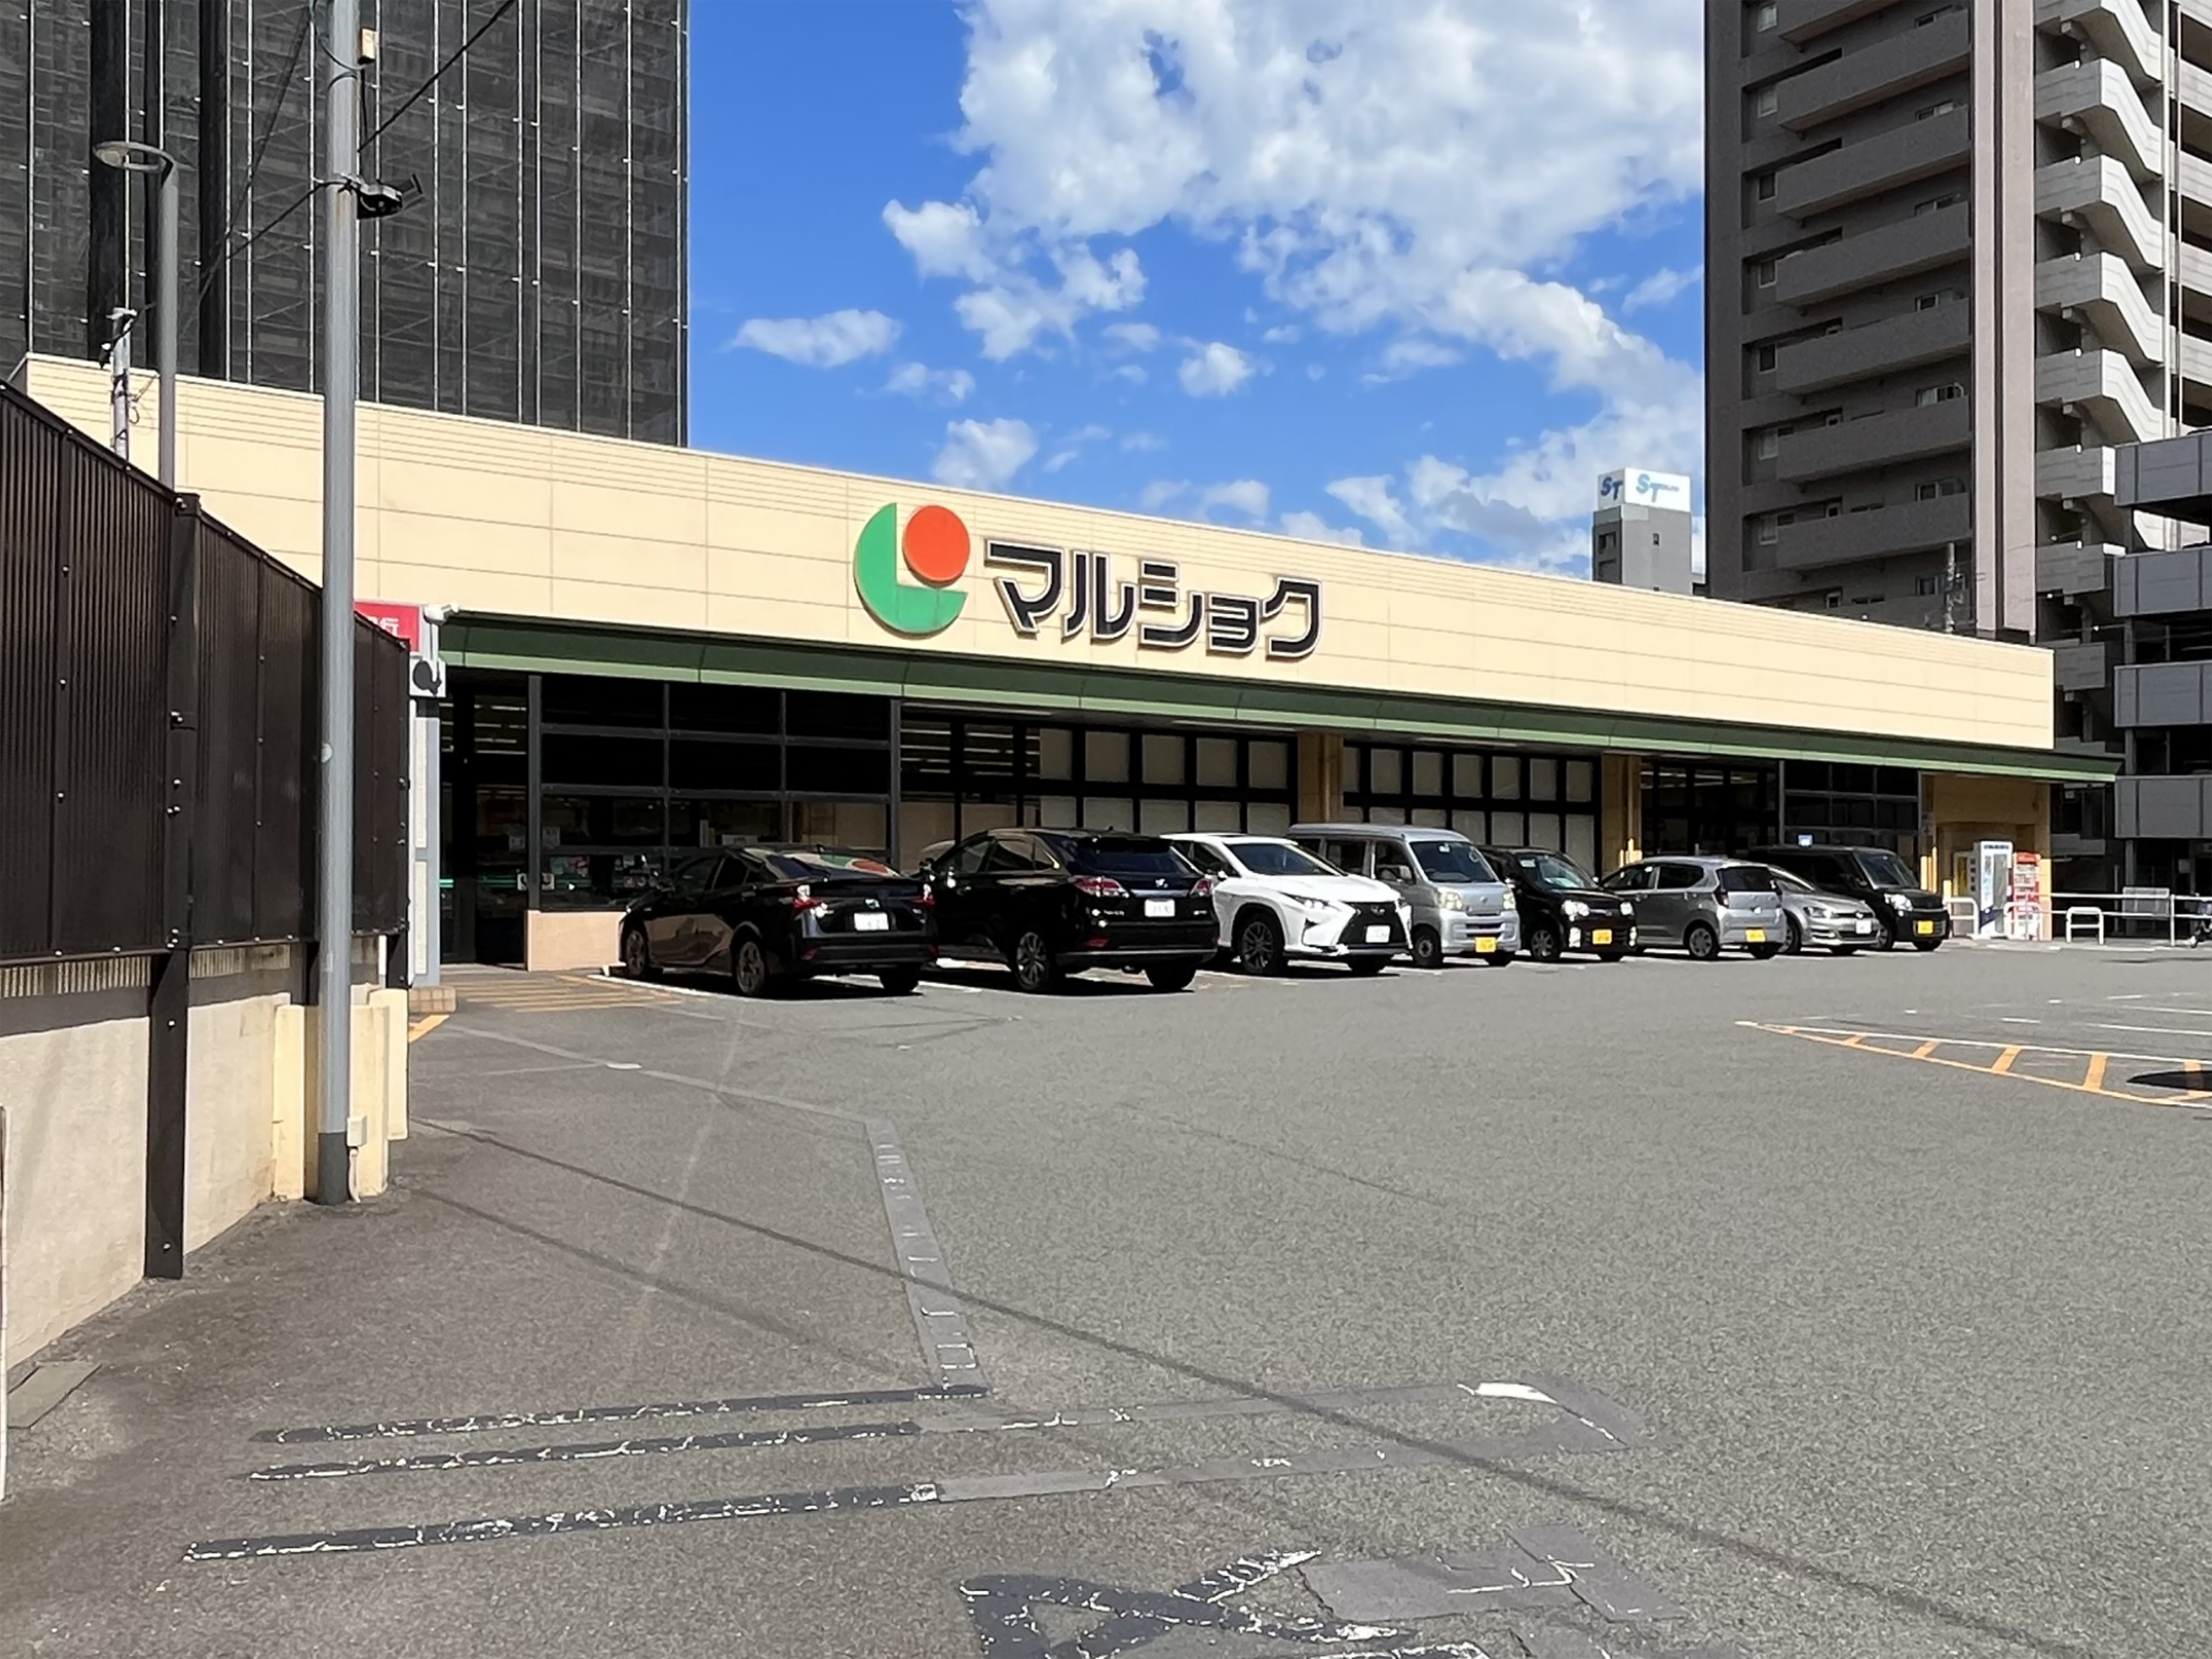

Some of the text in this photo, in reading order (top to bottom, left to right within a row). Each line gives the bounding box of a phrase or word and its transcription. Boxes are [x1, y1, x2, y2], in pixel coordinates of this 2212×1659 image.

[985, 538, 1322, 660] マルショク
